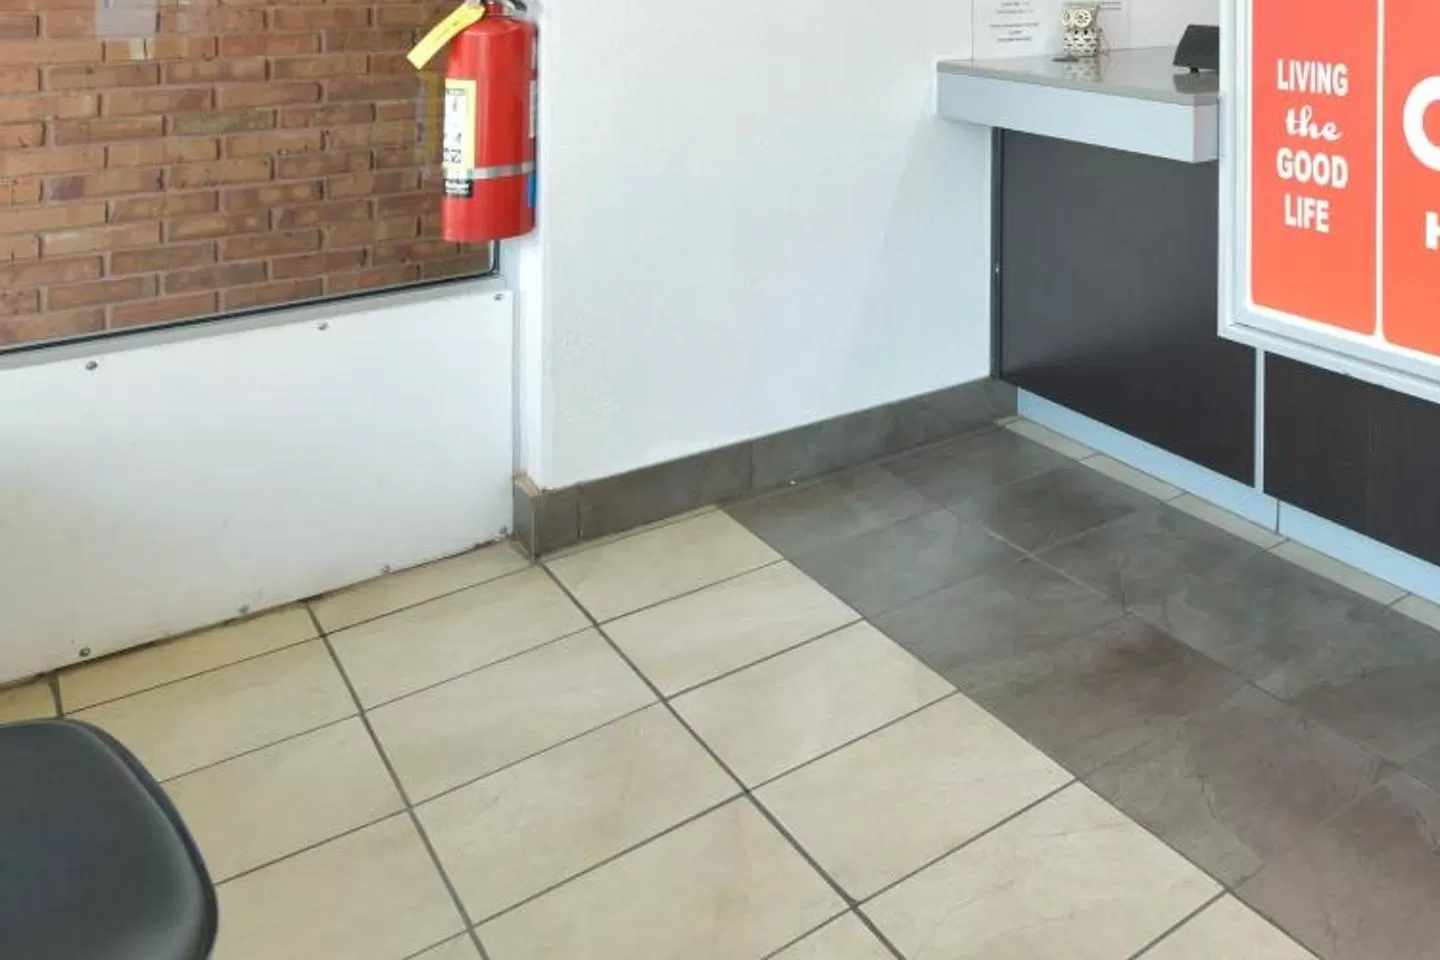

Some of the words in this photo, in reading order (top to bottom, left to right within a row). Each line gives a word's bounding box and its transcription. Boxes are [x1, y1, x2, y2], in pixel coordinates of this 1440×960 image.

[1276, 57, 1349, 97] LIVING
[1285, 104, 1344, 142] the
[1276, 146, 1349, 189] GOOD
[1283, 192, 1330, 234] LIFE
